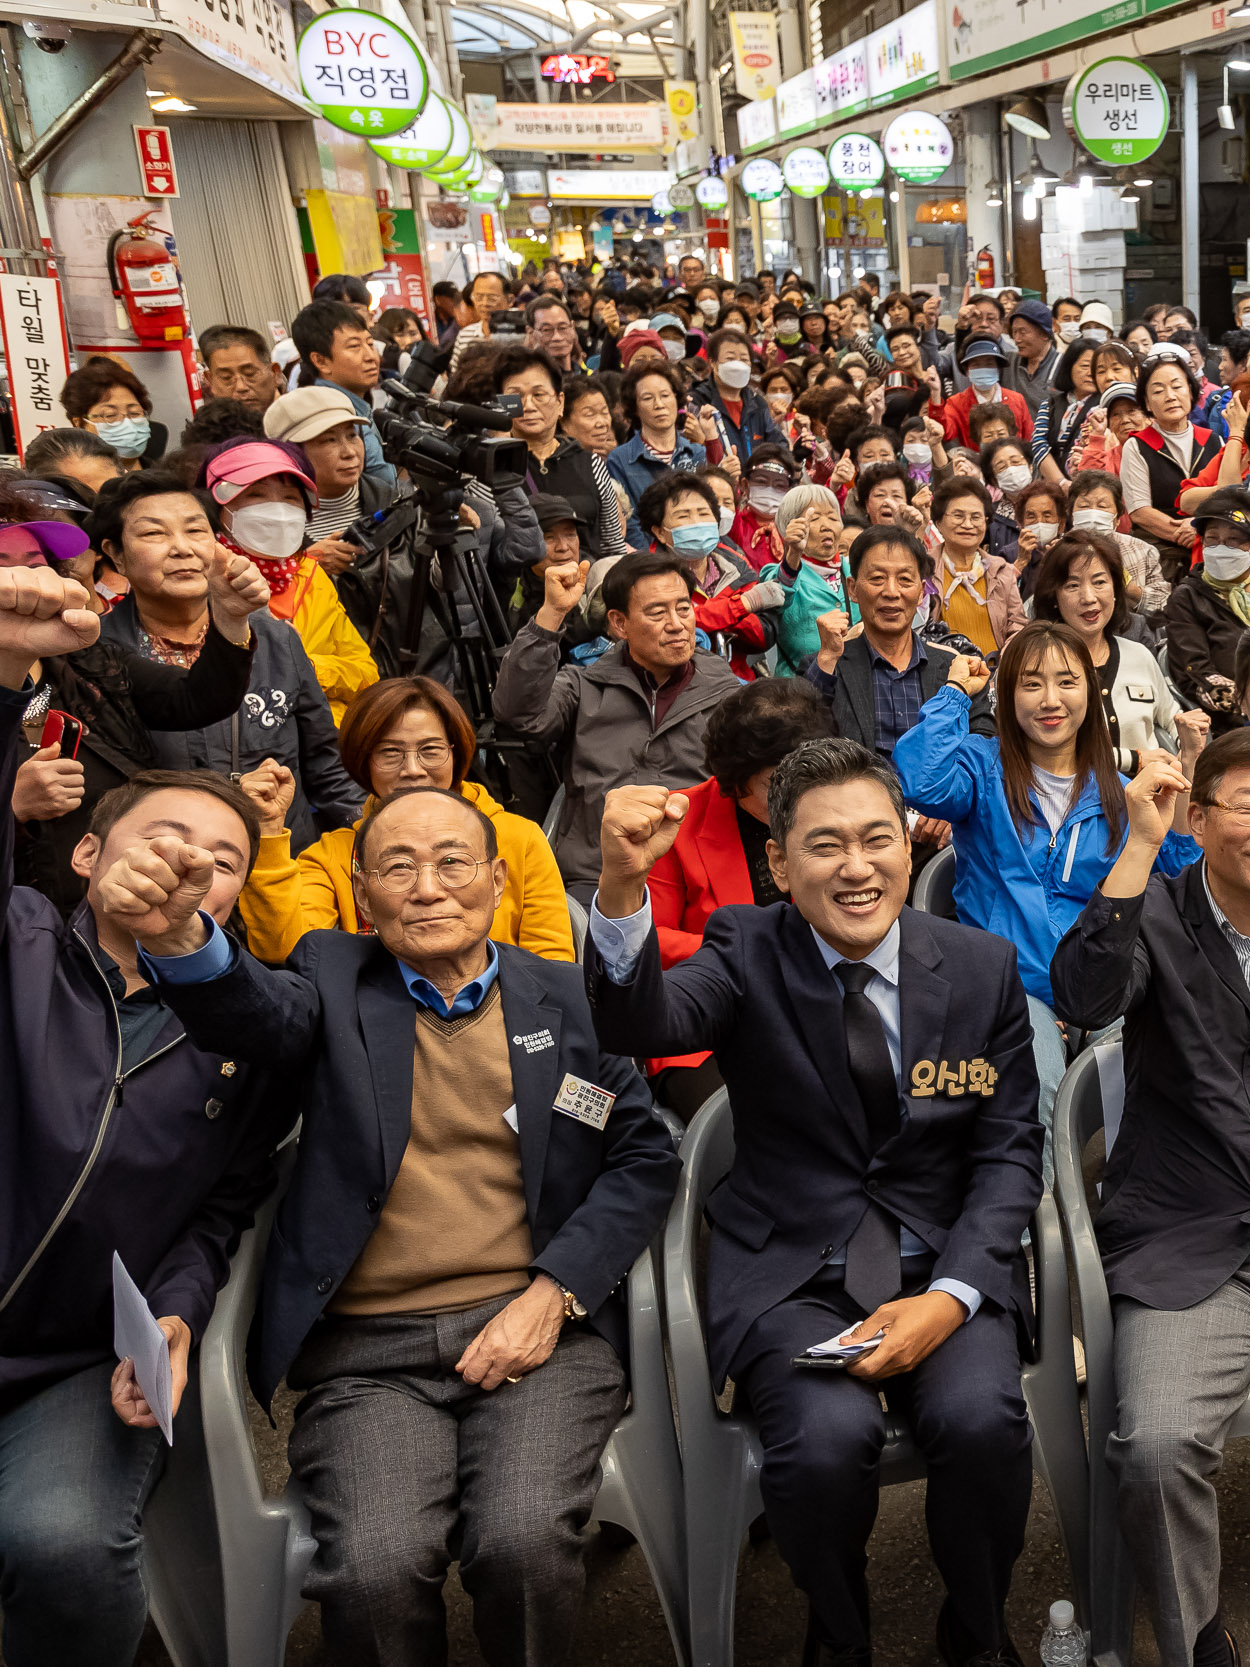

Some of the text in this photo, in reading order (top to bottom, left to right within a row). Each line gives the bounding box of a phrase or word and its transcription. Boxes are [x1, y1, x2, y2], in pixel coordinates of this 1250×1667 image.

[324, 30, 390, 58] BYC
[315, 65, 410, 100] 직영점
[1085, 83, 1154, 104] 우리마트
[349, 109, 385, 127] 속옷
[1103, 109, 1138, 131] 생선
[16, 289, 45, 344] 타월
[24, 356, 54, 411] 맞춤
[911, 1058, 998, 1097] 오신환
